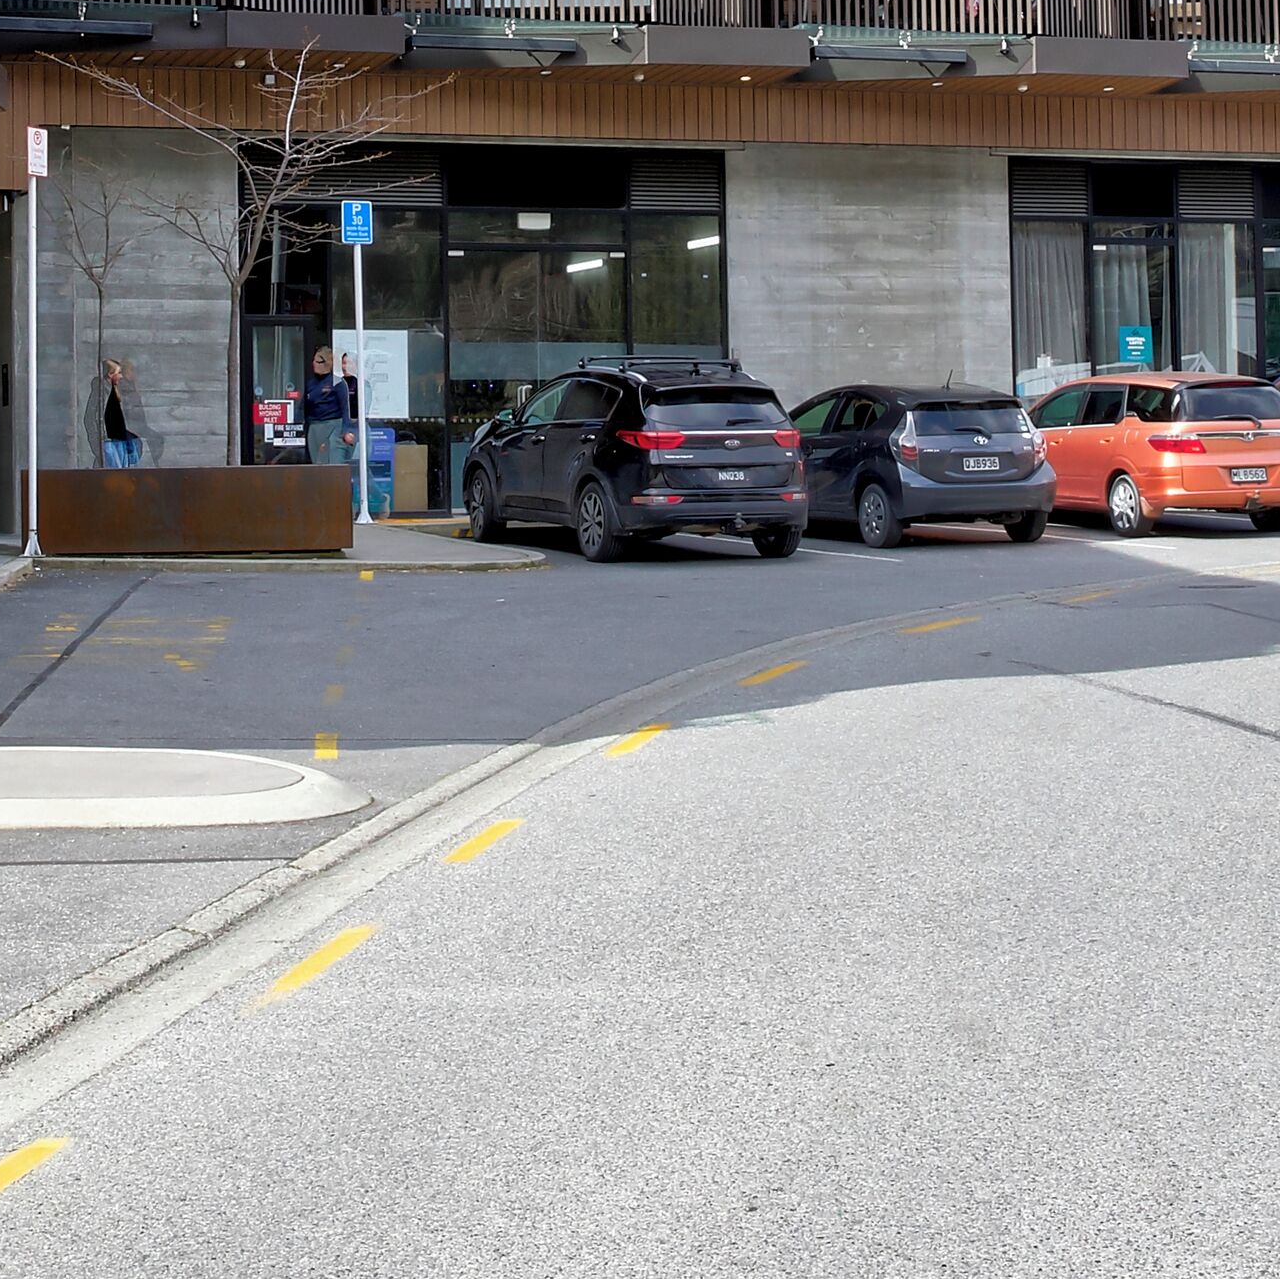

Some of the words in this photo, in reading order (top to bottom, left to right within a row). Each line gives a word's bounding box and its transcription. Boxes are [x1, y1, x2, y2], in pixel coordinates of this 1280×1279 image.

[352, 203, 362, 215] P
[351, 215, 363, 225] 30
[964, 458, 999, 469] QJB936
[718, 471, 745, 481] NNQ38
[1232, 468, 1266, 480] MLB562
